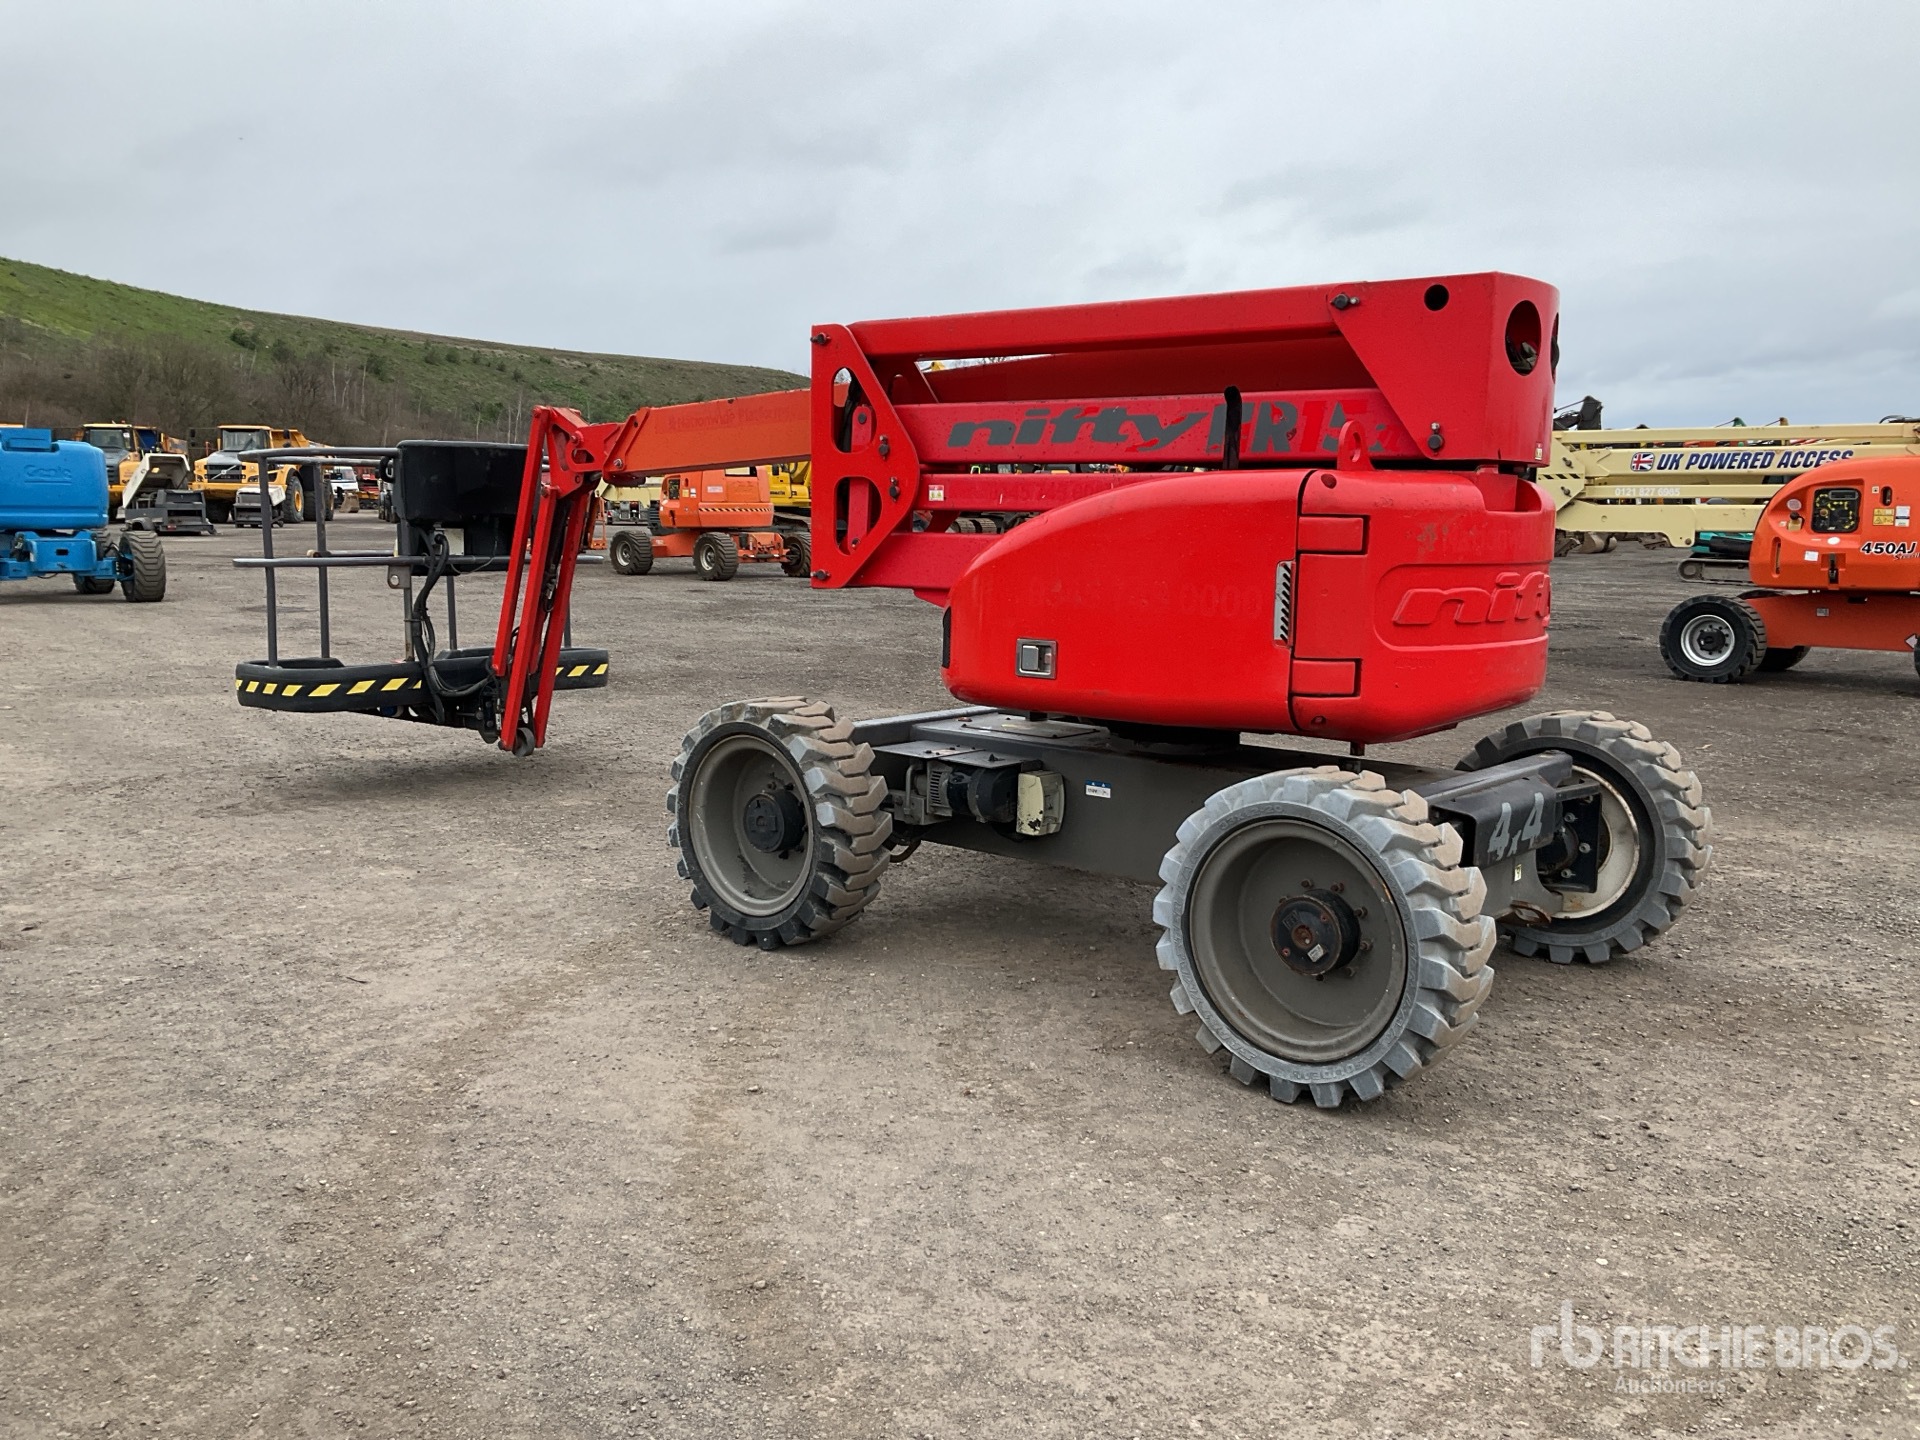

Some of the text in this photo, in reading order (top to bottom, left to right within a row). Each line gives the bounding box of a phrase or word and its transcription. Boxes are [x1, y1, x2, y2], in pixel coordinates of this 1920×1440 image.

[947, 406, 1208, 453] nifty
[1656, 453, 1684, 470] UK
[1685, 451, 1775, 470] POWERED
[1860, 541, 1917, 555] 450AJ
[1392, 571, 1550, 628] nift
